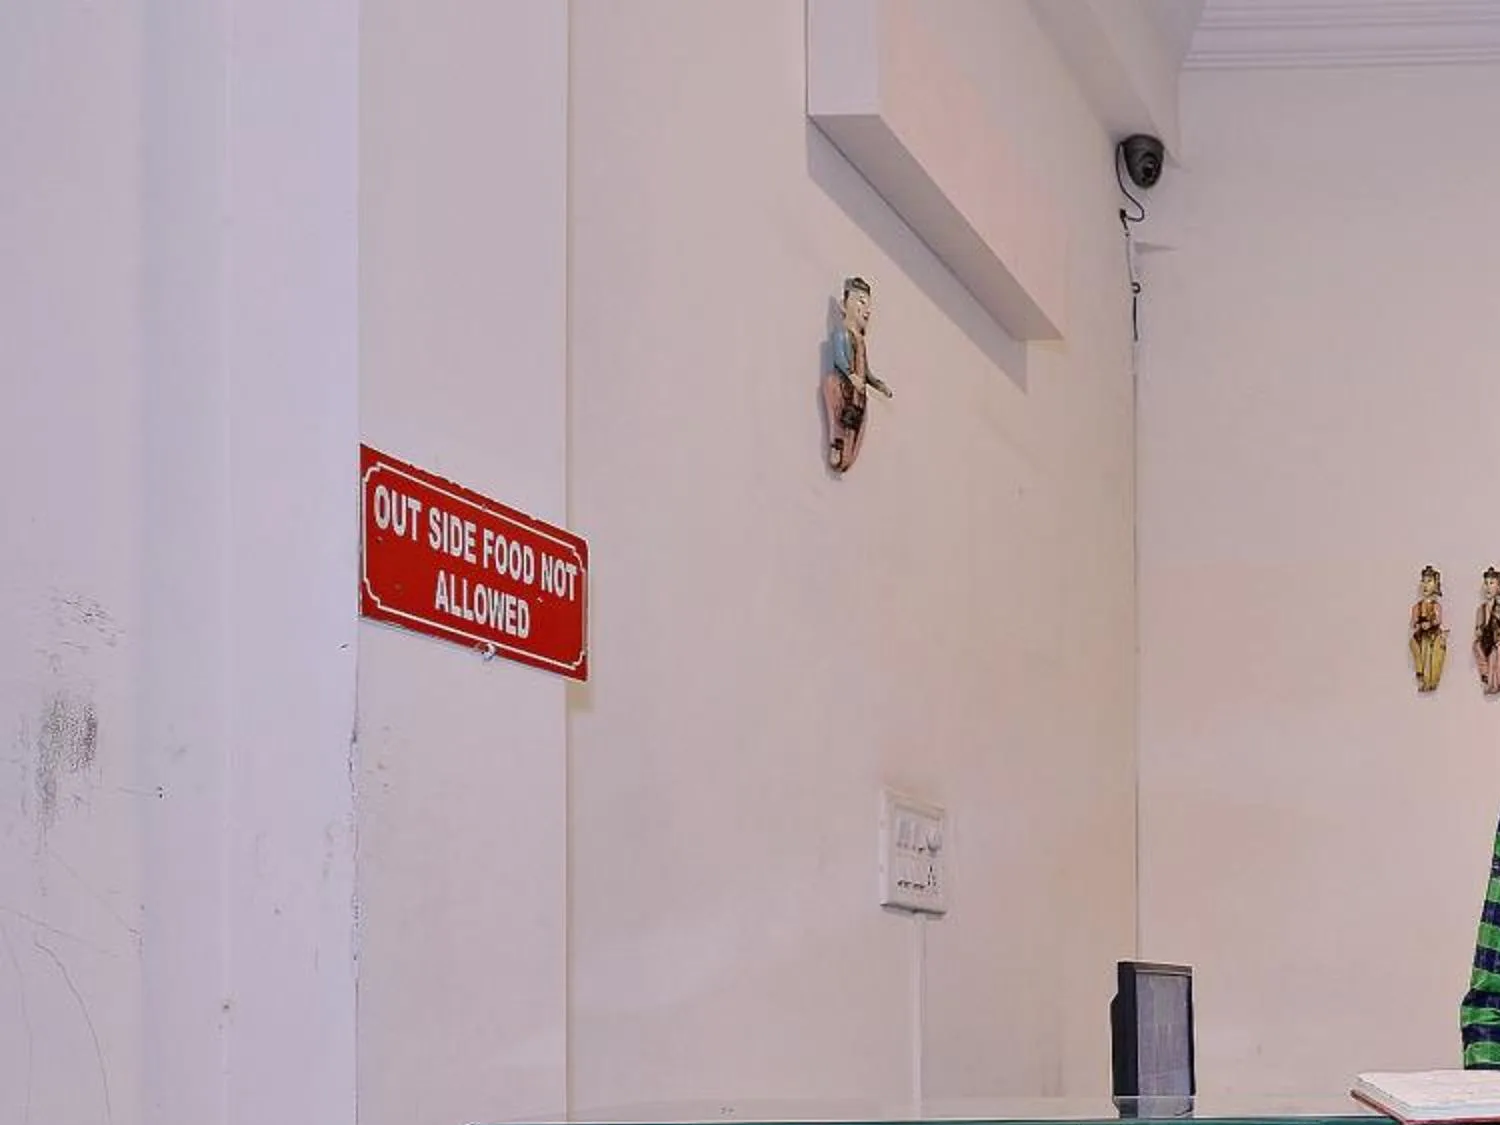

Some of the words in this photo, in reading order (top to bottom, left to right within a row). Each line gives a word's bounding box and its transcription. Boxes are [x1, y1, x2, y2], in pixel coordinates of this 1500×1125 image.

[374, 484, 421, 541] OUT
[428, 507, 476, 565] SIDE
[483, 528, 534, 585] FOOD
[541, 552, 577, 601] NOT
[435, 570, 530, 639] ALLOWED
